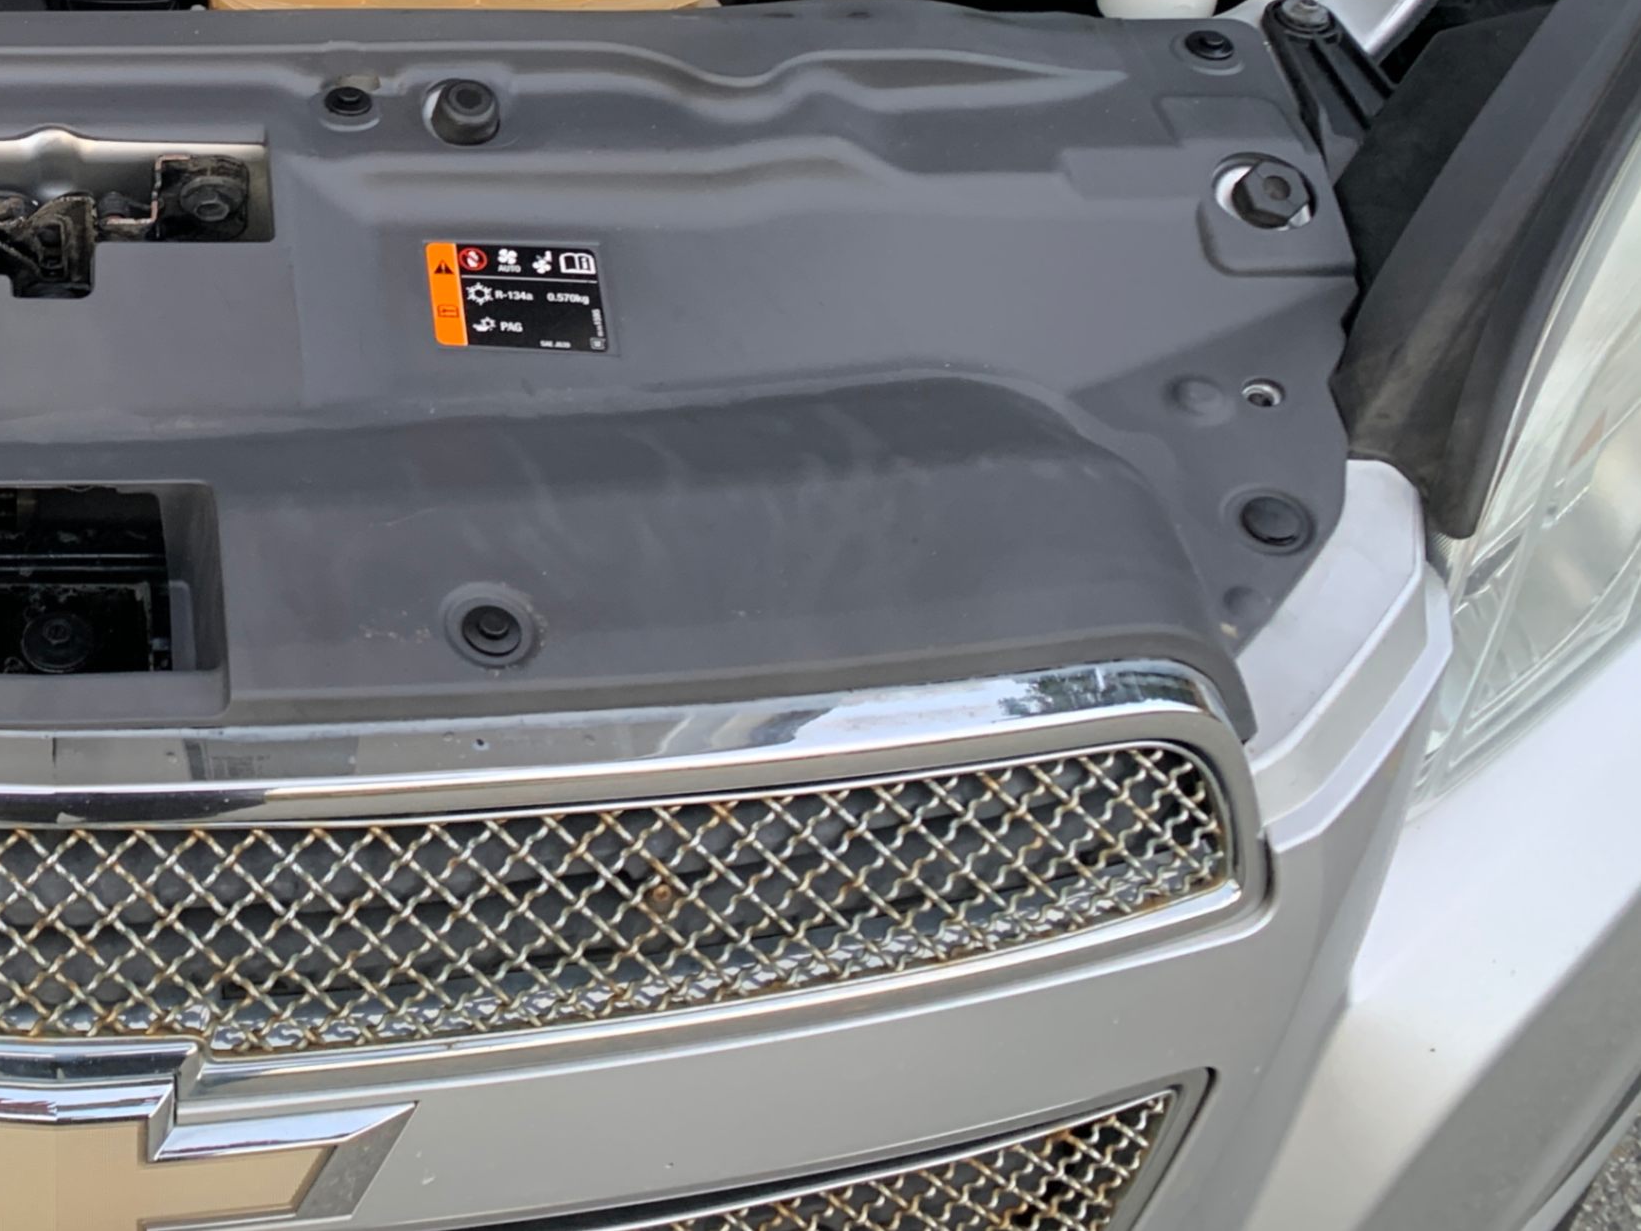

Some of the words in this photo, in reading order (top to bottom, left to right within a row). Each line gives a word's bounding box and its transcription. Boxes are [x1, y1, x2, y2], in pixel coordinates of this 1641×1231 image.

[497, 264, 522, 273] AUTO
[494, 289, 534, 301] R-134a
[500, 321, 523, 332] PAG
